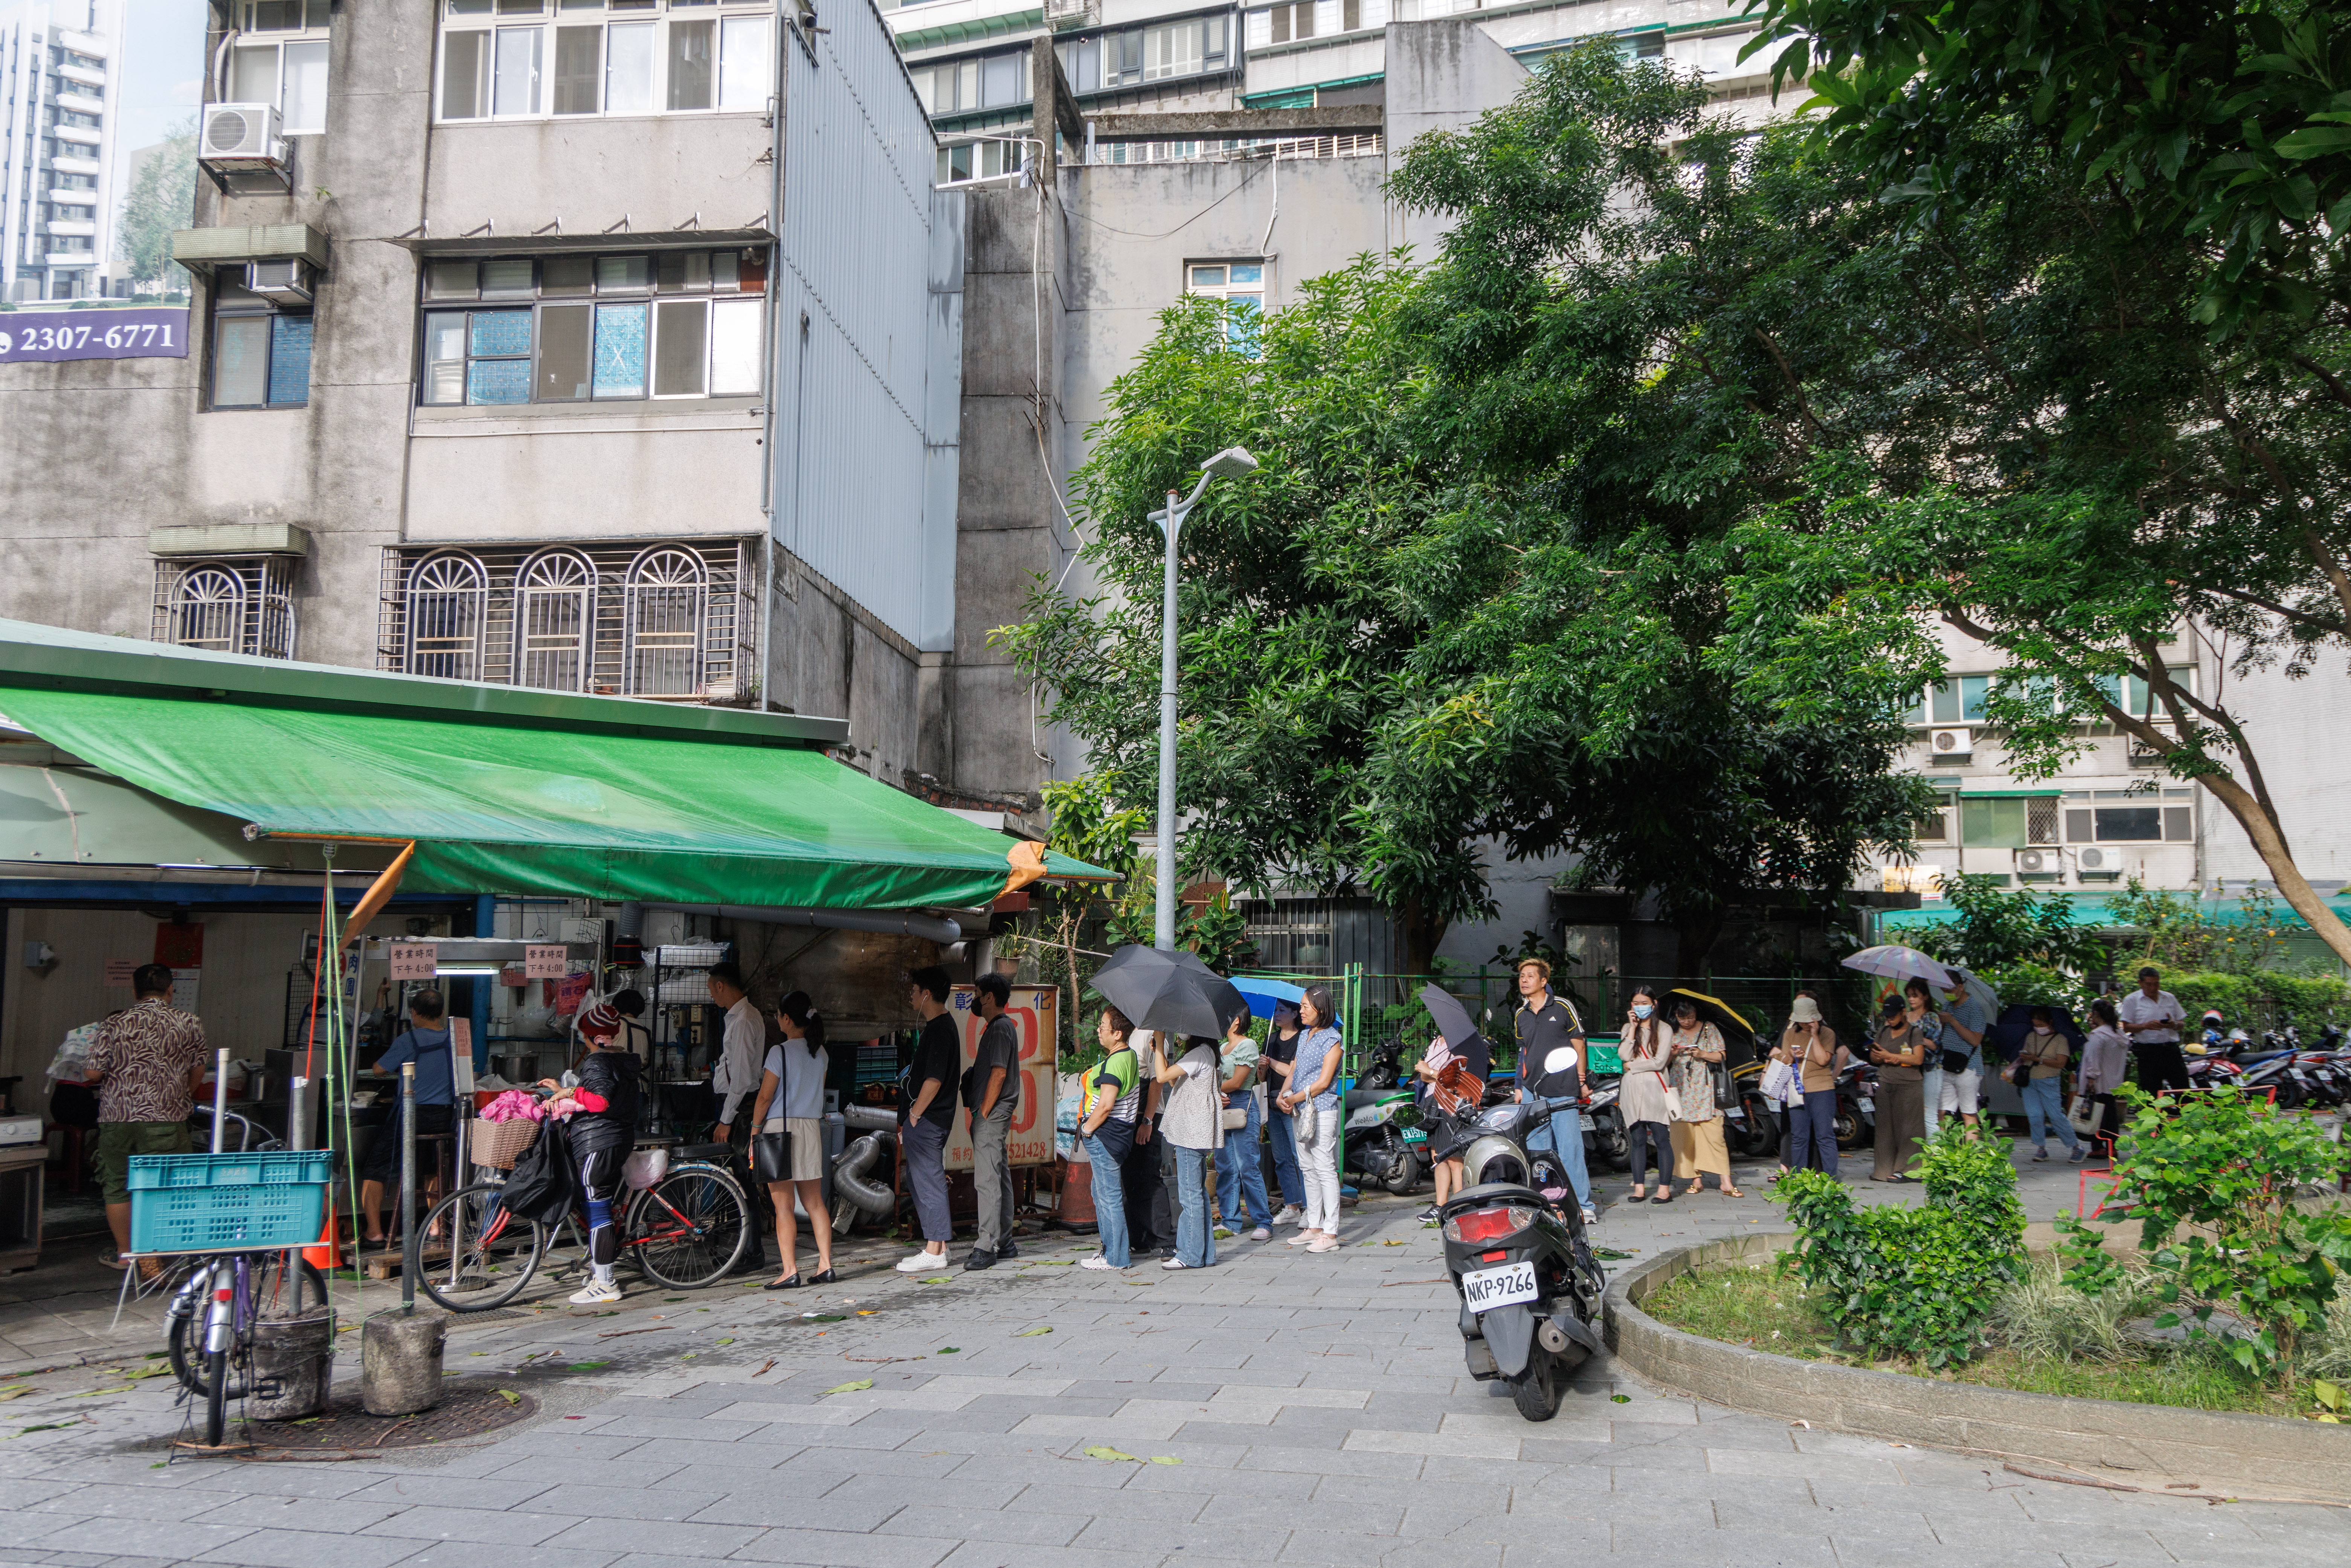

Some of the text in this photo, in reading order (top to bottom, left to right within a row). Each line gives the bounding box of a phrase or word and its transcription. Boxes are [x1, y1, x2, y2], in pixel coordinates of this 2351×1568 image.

[20, 325, 174, 350] 2307-6771
[394, 949, 433, 959] 營業時間
[529, 950, 563, 959] 營業時間
[1594, 1054, 1614, 1062] Uber
[1595, 1063, 1613, 1071] Eats
[1355, 1116, 1373, 1125] WeMo
[952, 1147, 972, 1162] 預約
[1467, 1272, 1533, 1303] NKP-9266
